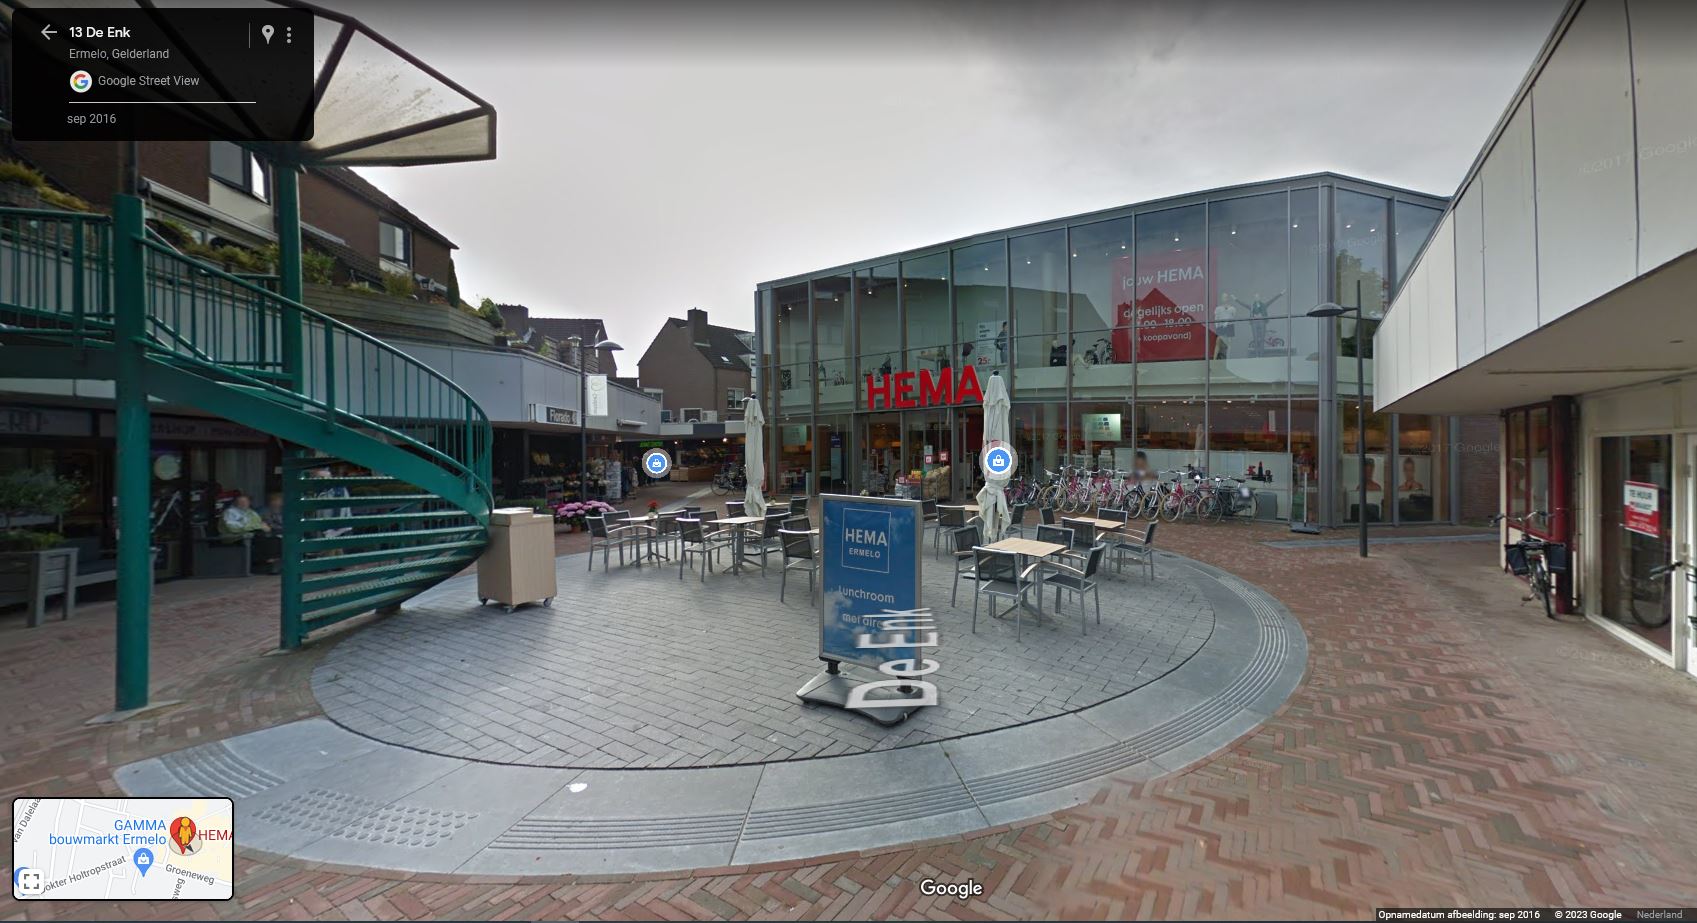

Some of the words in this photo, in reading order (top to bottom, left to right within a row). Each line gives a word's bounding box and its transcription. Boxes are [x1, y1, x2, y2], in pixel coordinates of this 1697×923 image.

[1157, 265, 1205, 284] HEMA
[1174, 303, 1205, 318] open
[1143, 331, 1192, 343] koopavond)
[866, 364, 984, 411] HEMA
[845, 527, 888, 547] HEMA
[848, 547, 881, 559] ERMELO
[838, 585, 895, 604] Lunchroom
